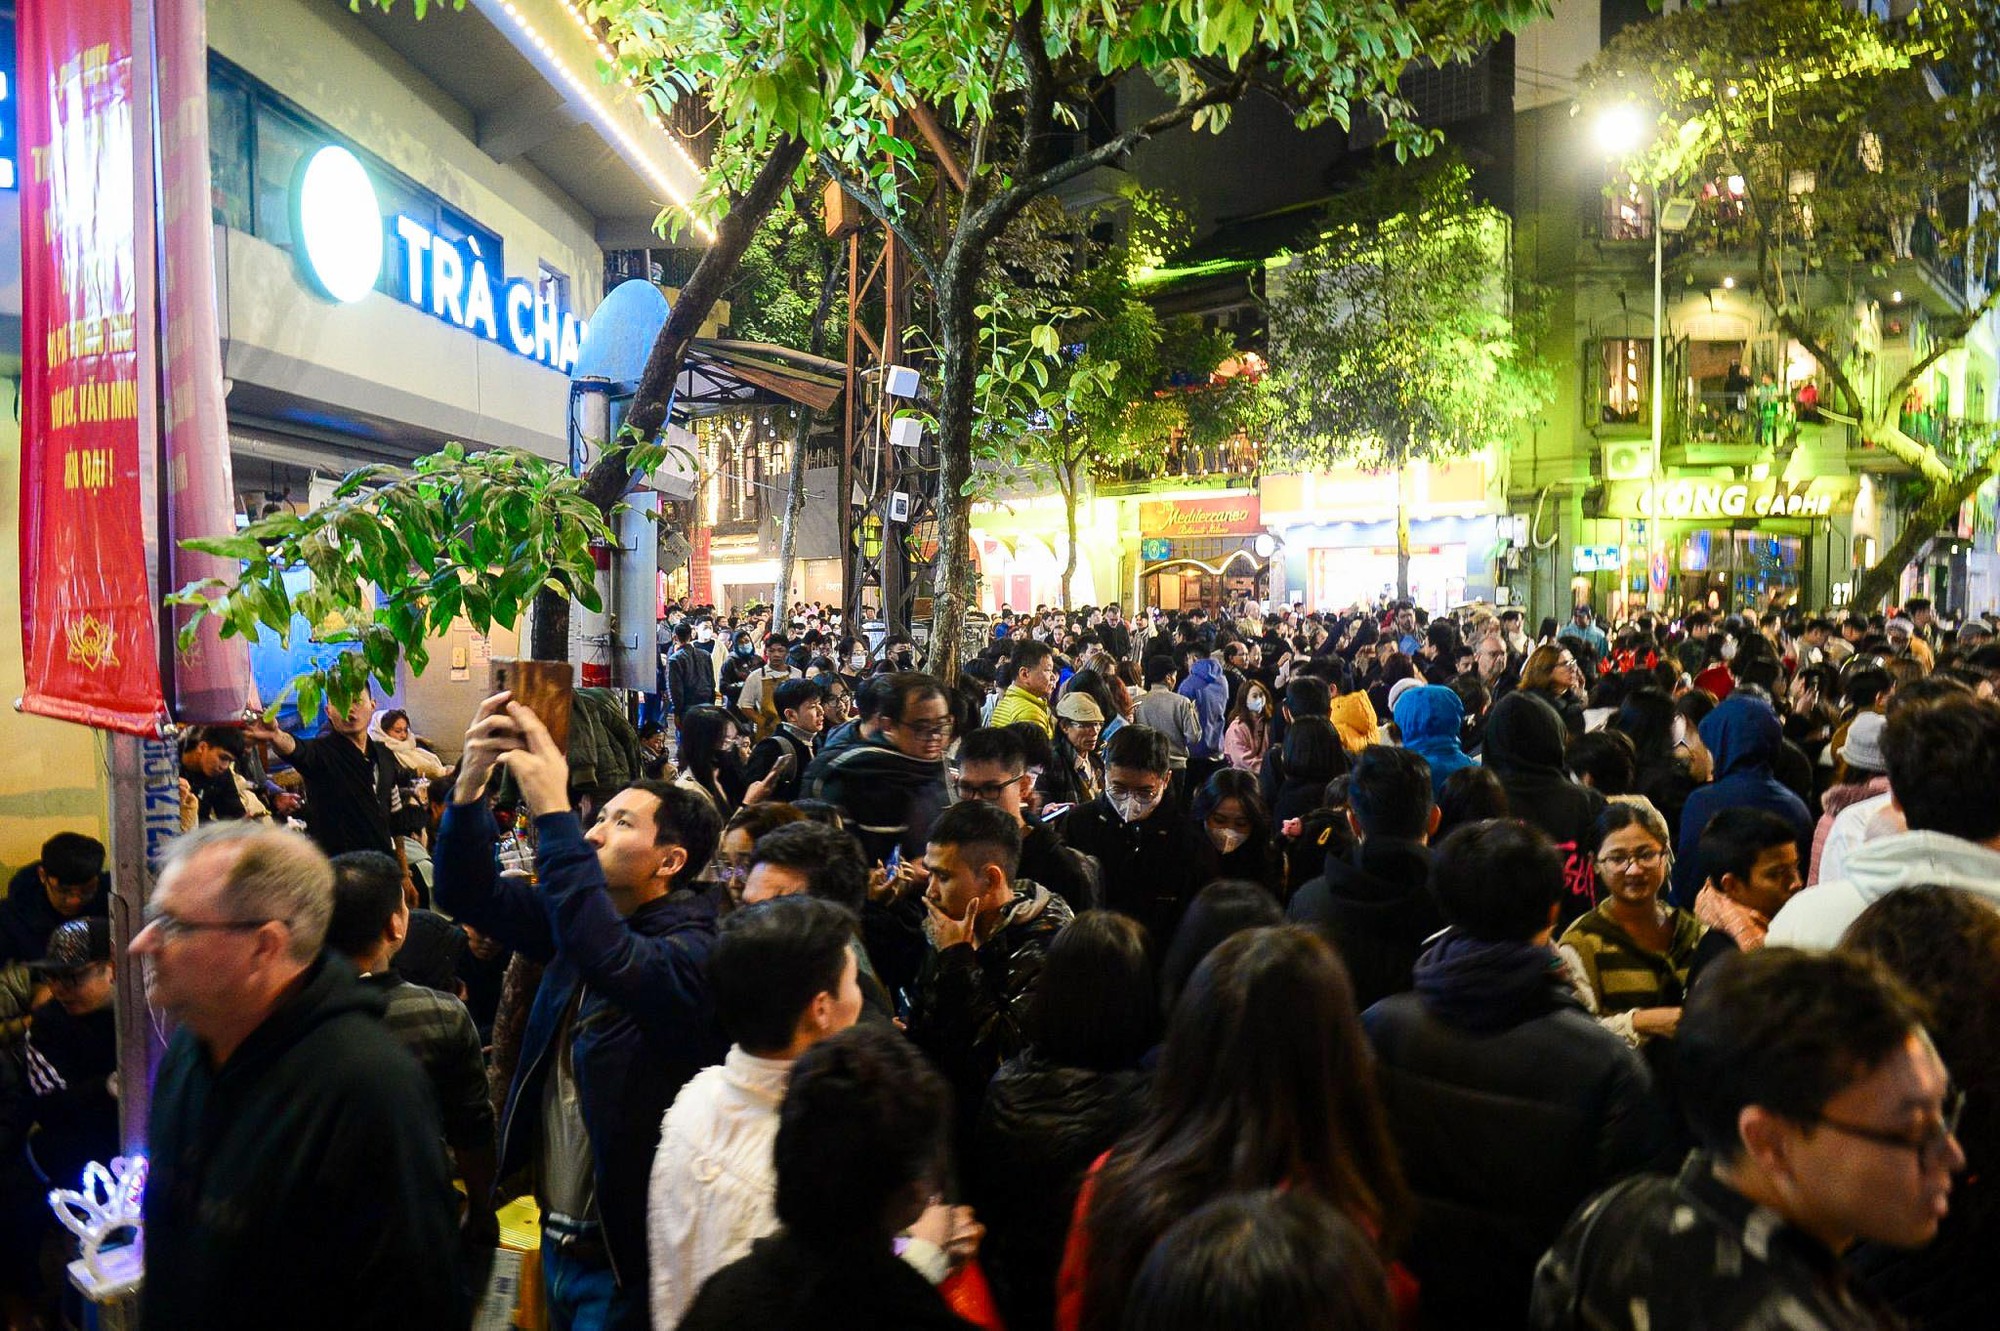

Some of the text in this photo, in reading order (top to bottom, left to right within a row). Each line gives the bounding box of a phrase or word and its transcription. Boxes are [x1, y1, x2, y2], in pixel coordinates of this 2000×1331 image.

[398, 214, 589, 372] TRÀ CHA
[79, 374, 108, 423] VĂN
[1832, 582, 1851, 605] 27
